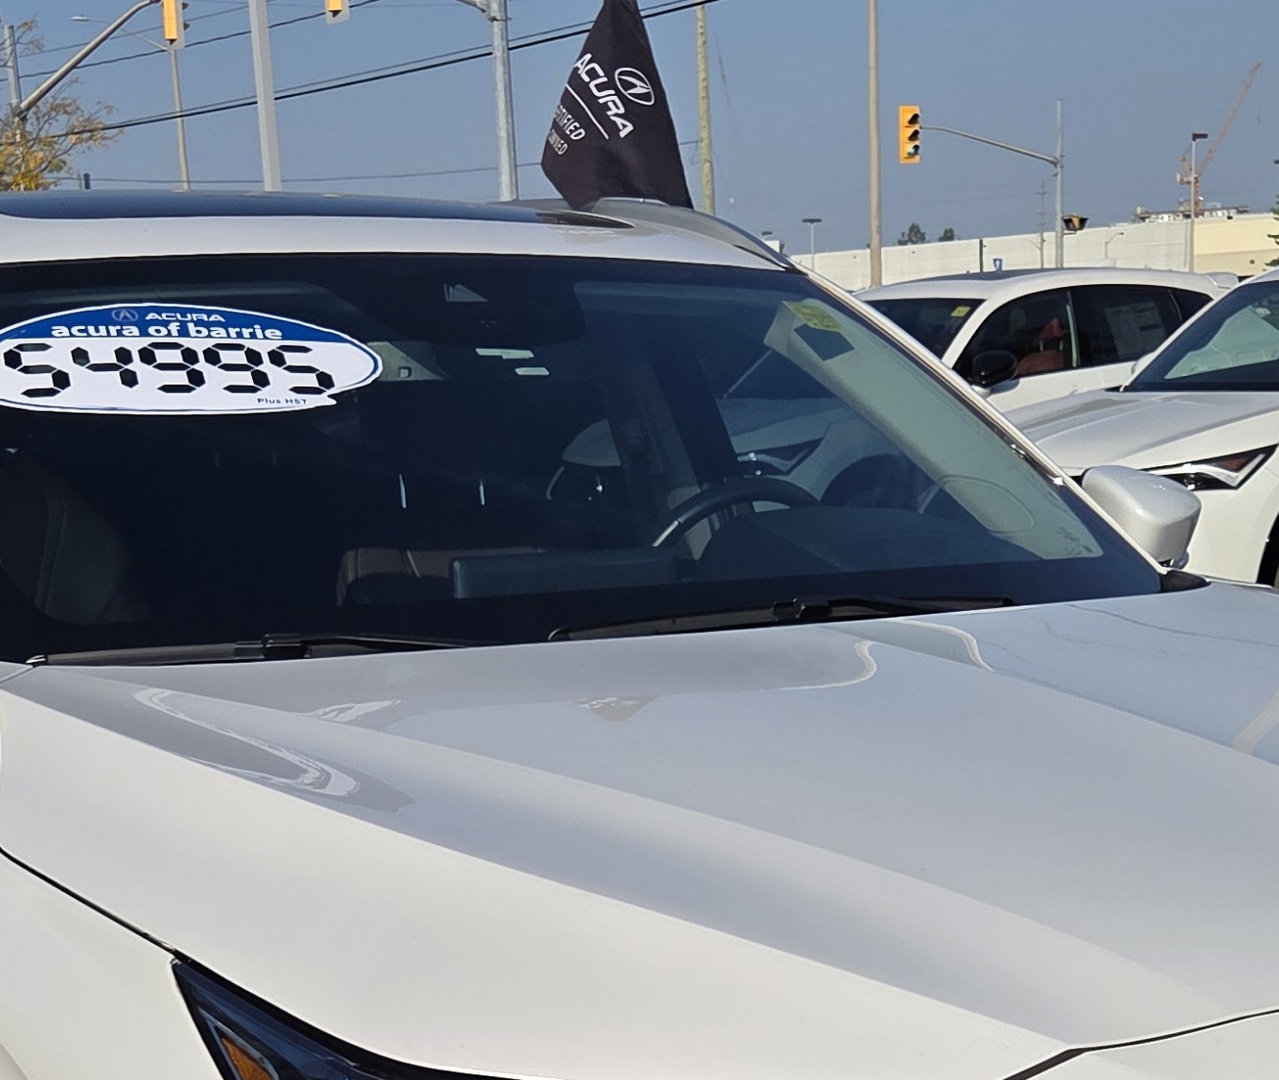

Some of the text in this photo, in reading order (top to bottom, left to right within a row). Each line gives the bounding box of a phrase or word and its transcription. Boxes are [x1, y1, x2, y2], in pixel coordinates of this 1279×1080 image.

[574, 53, 634, 138] ACURA
[145, 312, 225, 322] ACURA
[51, 322, 283, 340] acura of barrie
[3, 341, 335, 398] 54995
[257, 397, 281, 405] Plus
